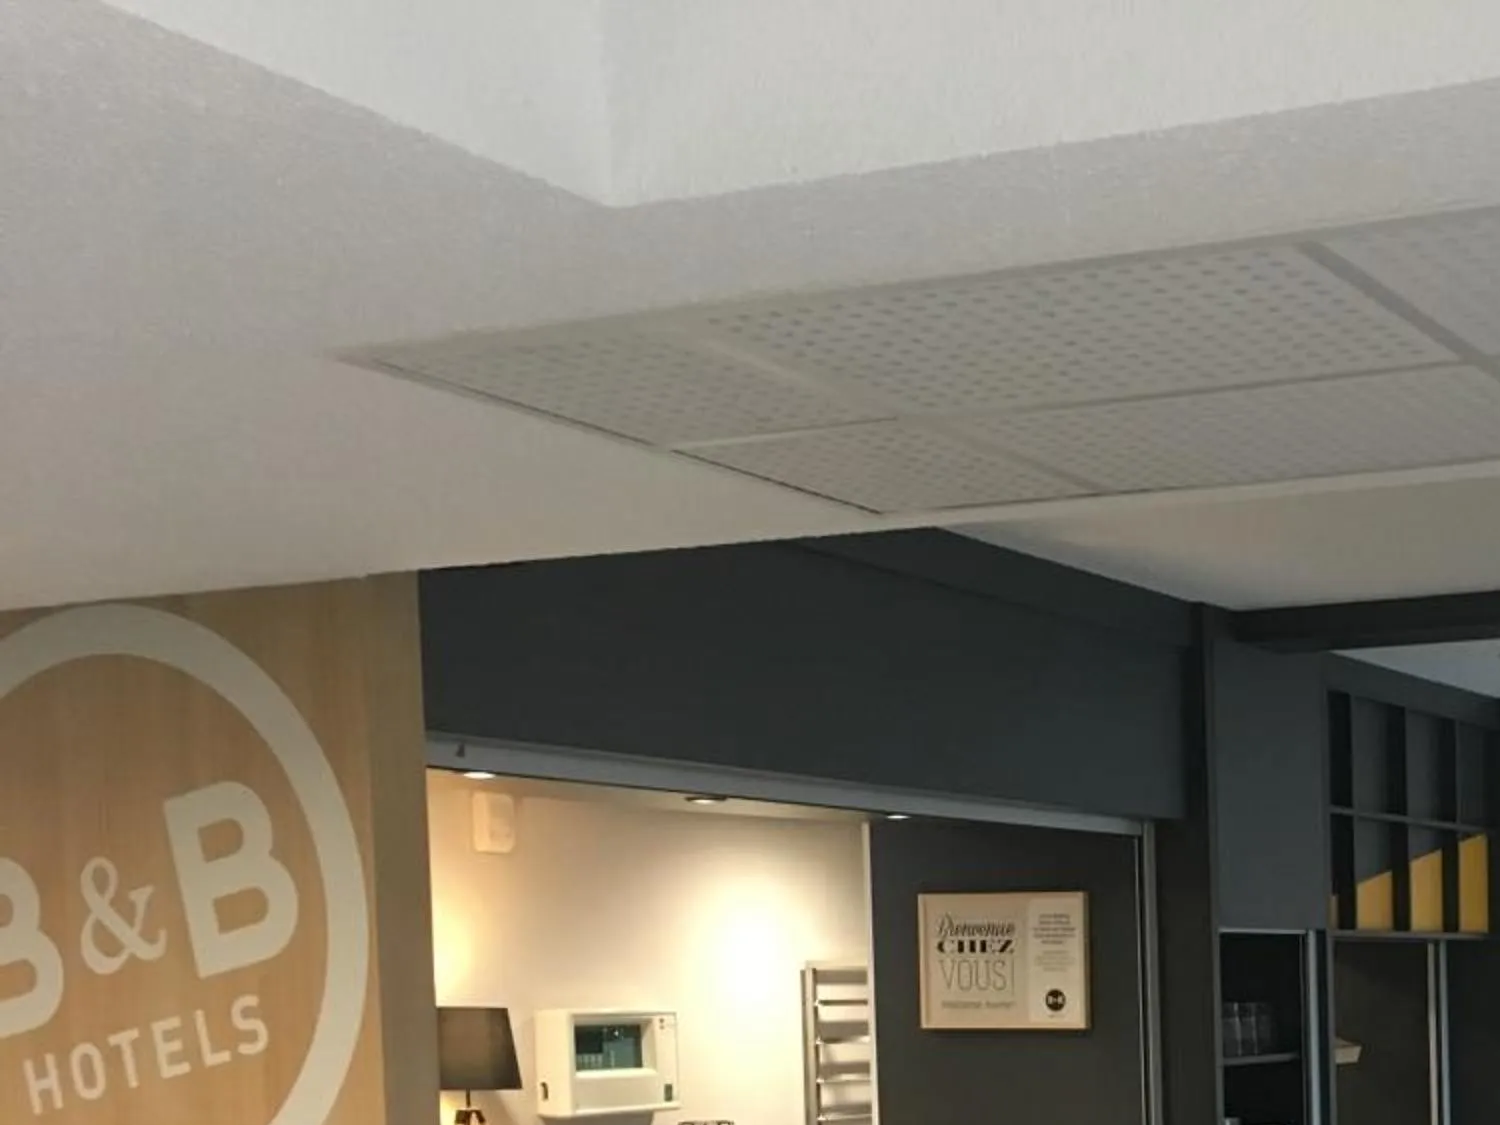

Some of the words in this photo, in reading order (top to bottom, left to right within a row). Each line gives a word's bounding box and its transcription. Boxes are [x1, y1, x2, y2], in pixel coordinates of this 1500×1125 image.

[937, 911, 1016, 938] Bienvenue
[937, 939, 1015, 954] CHEZ
[23, 994, 270, 1116] HOTELS
